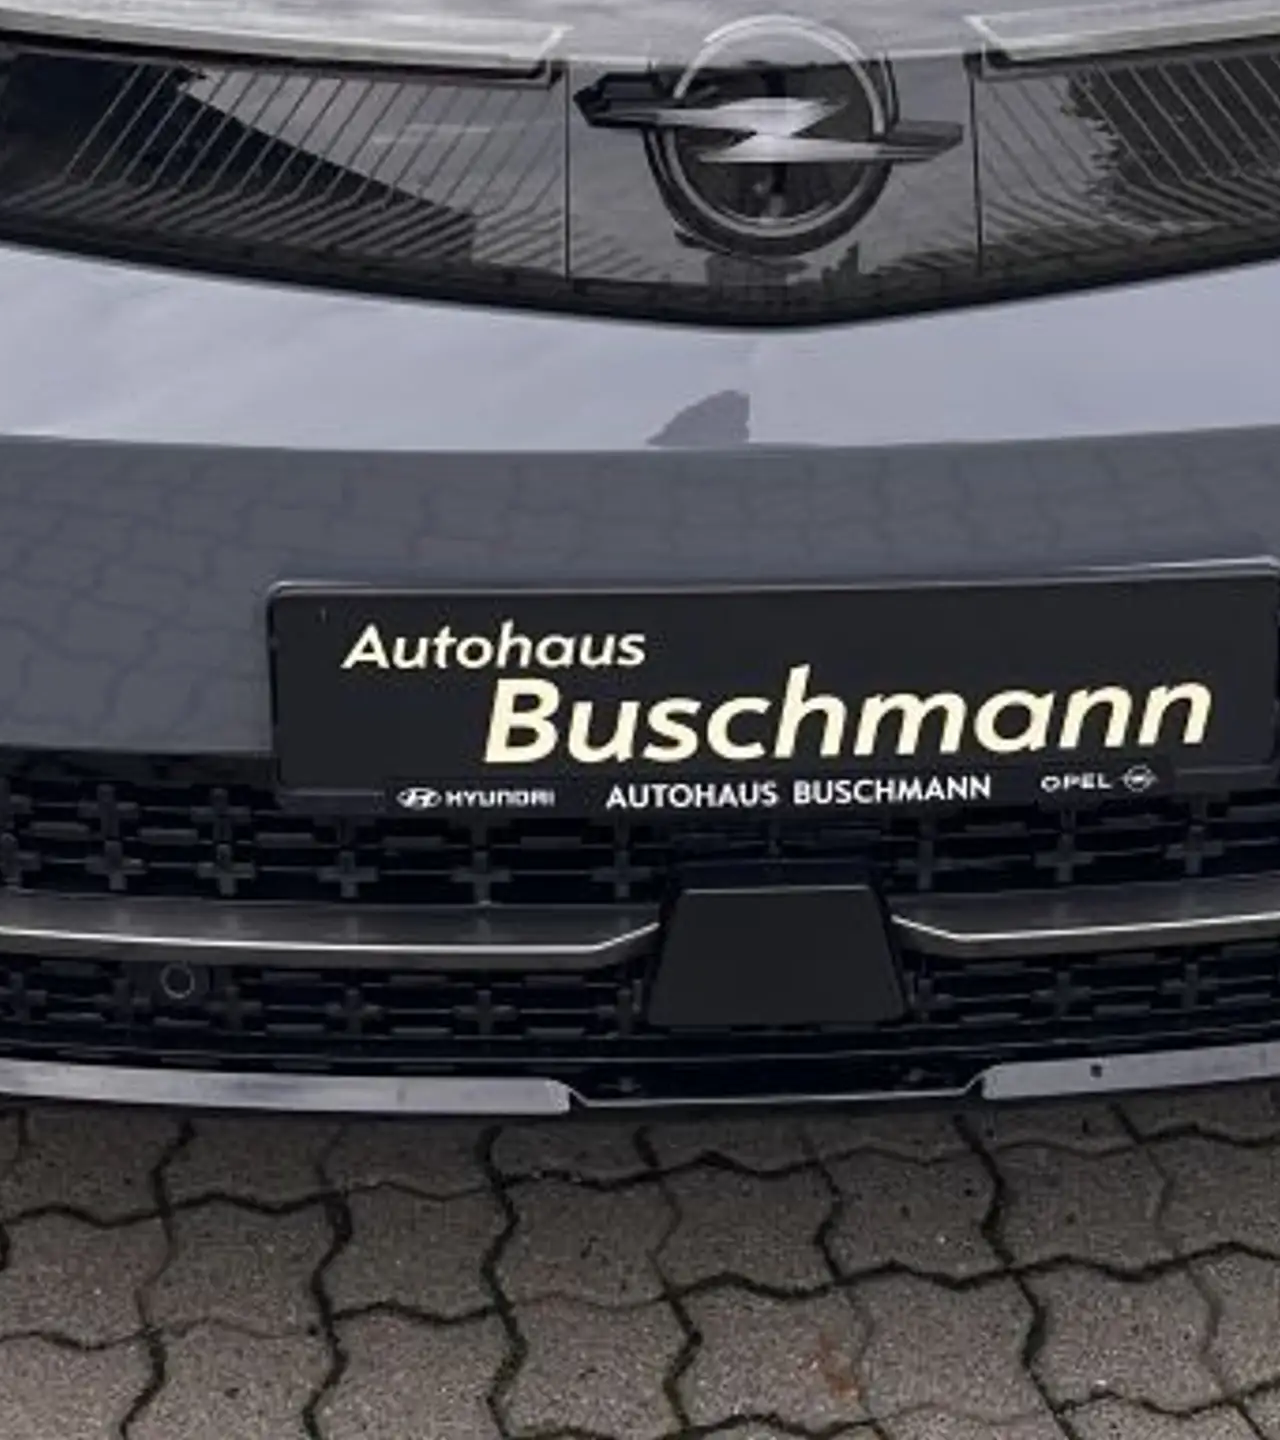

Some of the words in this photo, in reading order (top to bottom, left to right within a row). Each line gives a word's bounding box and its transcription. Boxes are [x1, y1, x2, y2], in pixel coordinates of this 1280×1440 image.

[339, 619, 646, 669] Autohaus
[484, 663, 1212, 764] Buschmann
[445, 789, 556, 808] HYUNDAI
[605, 780, 780, 810] AUTOHAUS
[792, 773, 992, 806] BUSCHMANN
[1039, 772, 1113, 793] OPEL
